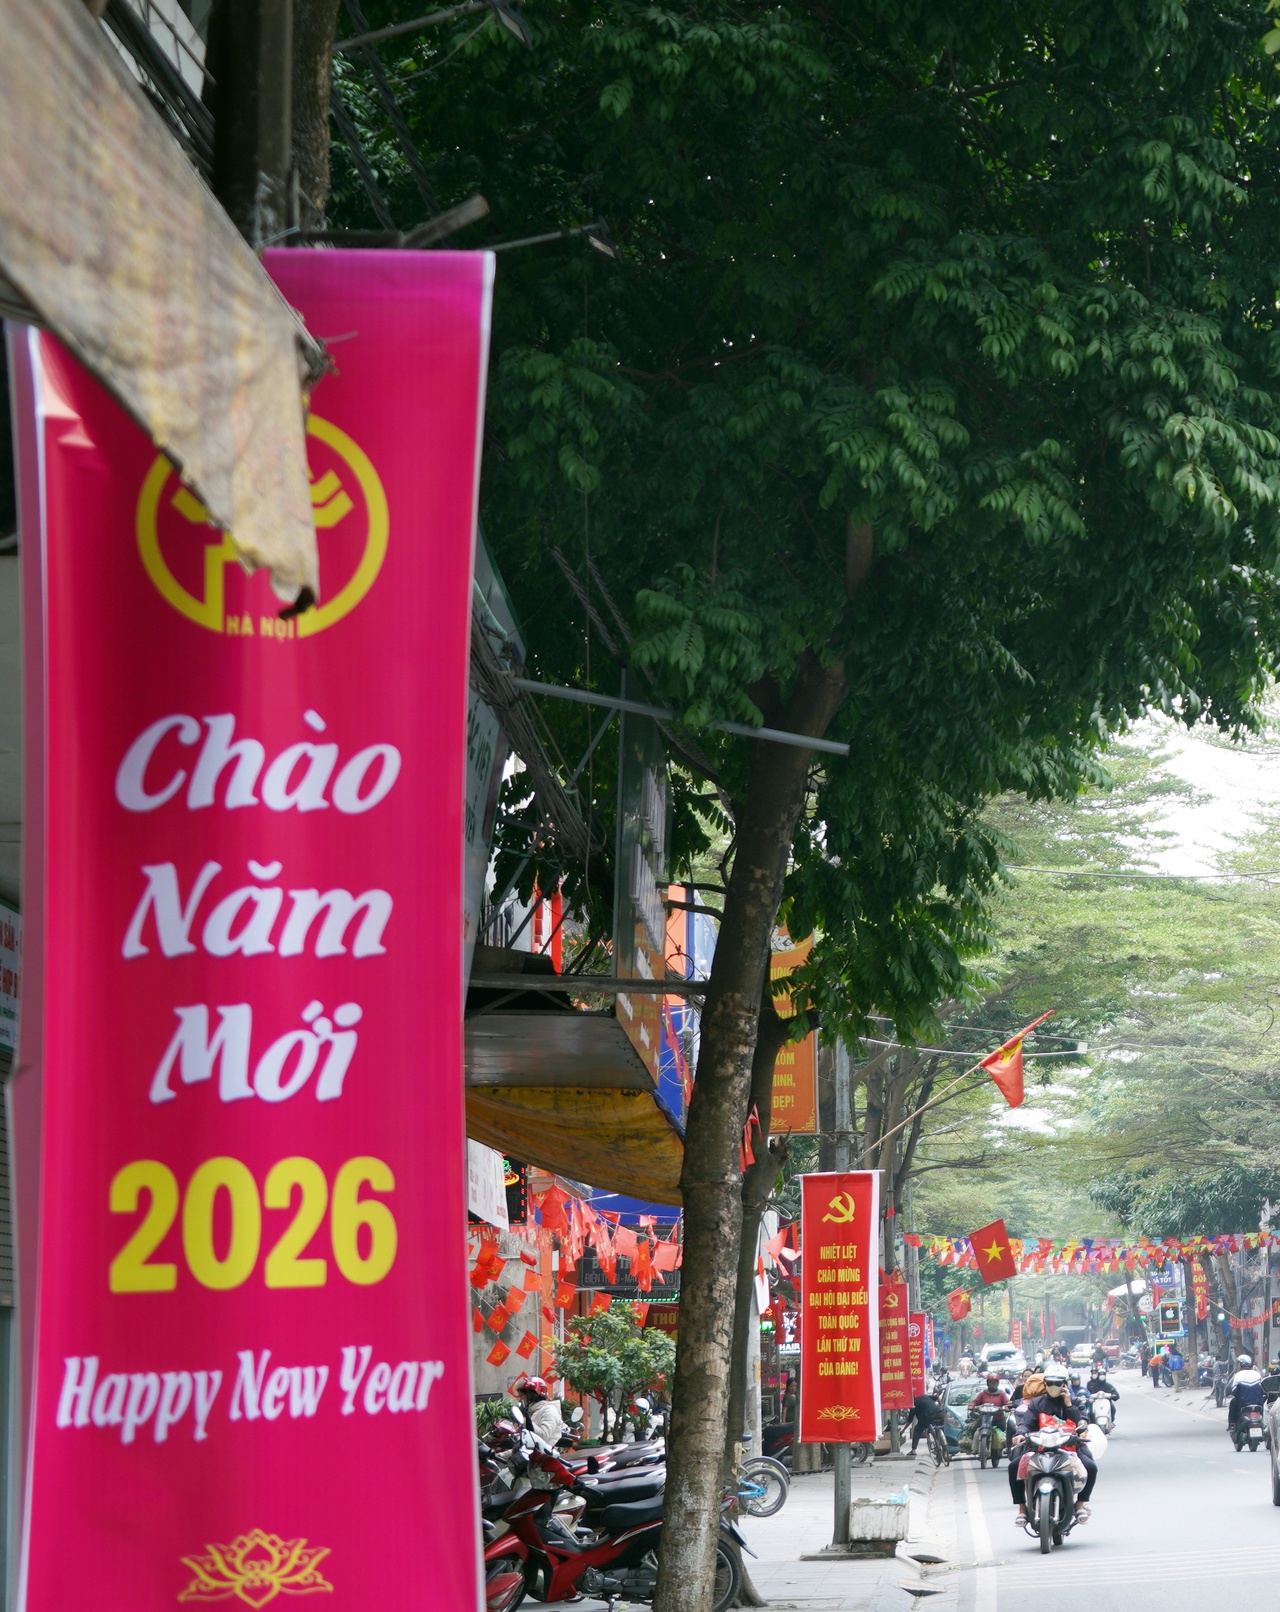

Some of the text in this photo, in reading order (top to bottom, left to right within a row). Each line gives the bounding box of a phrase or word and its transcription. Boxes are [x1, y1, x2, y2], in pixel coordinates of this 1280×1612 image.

[226, 613, 295, 641] HÀ NỘI
[115, 709, 401, 814] Chào
[122, 859, 394, 959] Năm
[149, 1000, 363, 1103] Mới
[108, 1156, 398, 1293] 2026
[820, 1244, 857, 1261] NHIỆT LIỆT
[817, 1266, 860, 1283] CHÀO MỪNG
[809, 1286, 868, 1308] ĐẠI HỘI ĐẠI BIỂU
[818, 1309, 859, 1329] TOÀN QUỐC
[780, 1343, 800, 1351] HAIR
[817, 1335, 861, 1353] LẦN THỨ XIV
[818, 1357, 858, 1376] CỦA ĐẢNG!
[57, 1345, 445, 1445] Happy New Year
